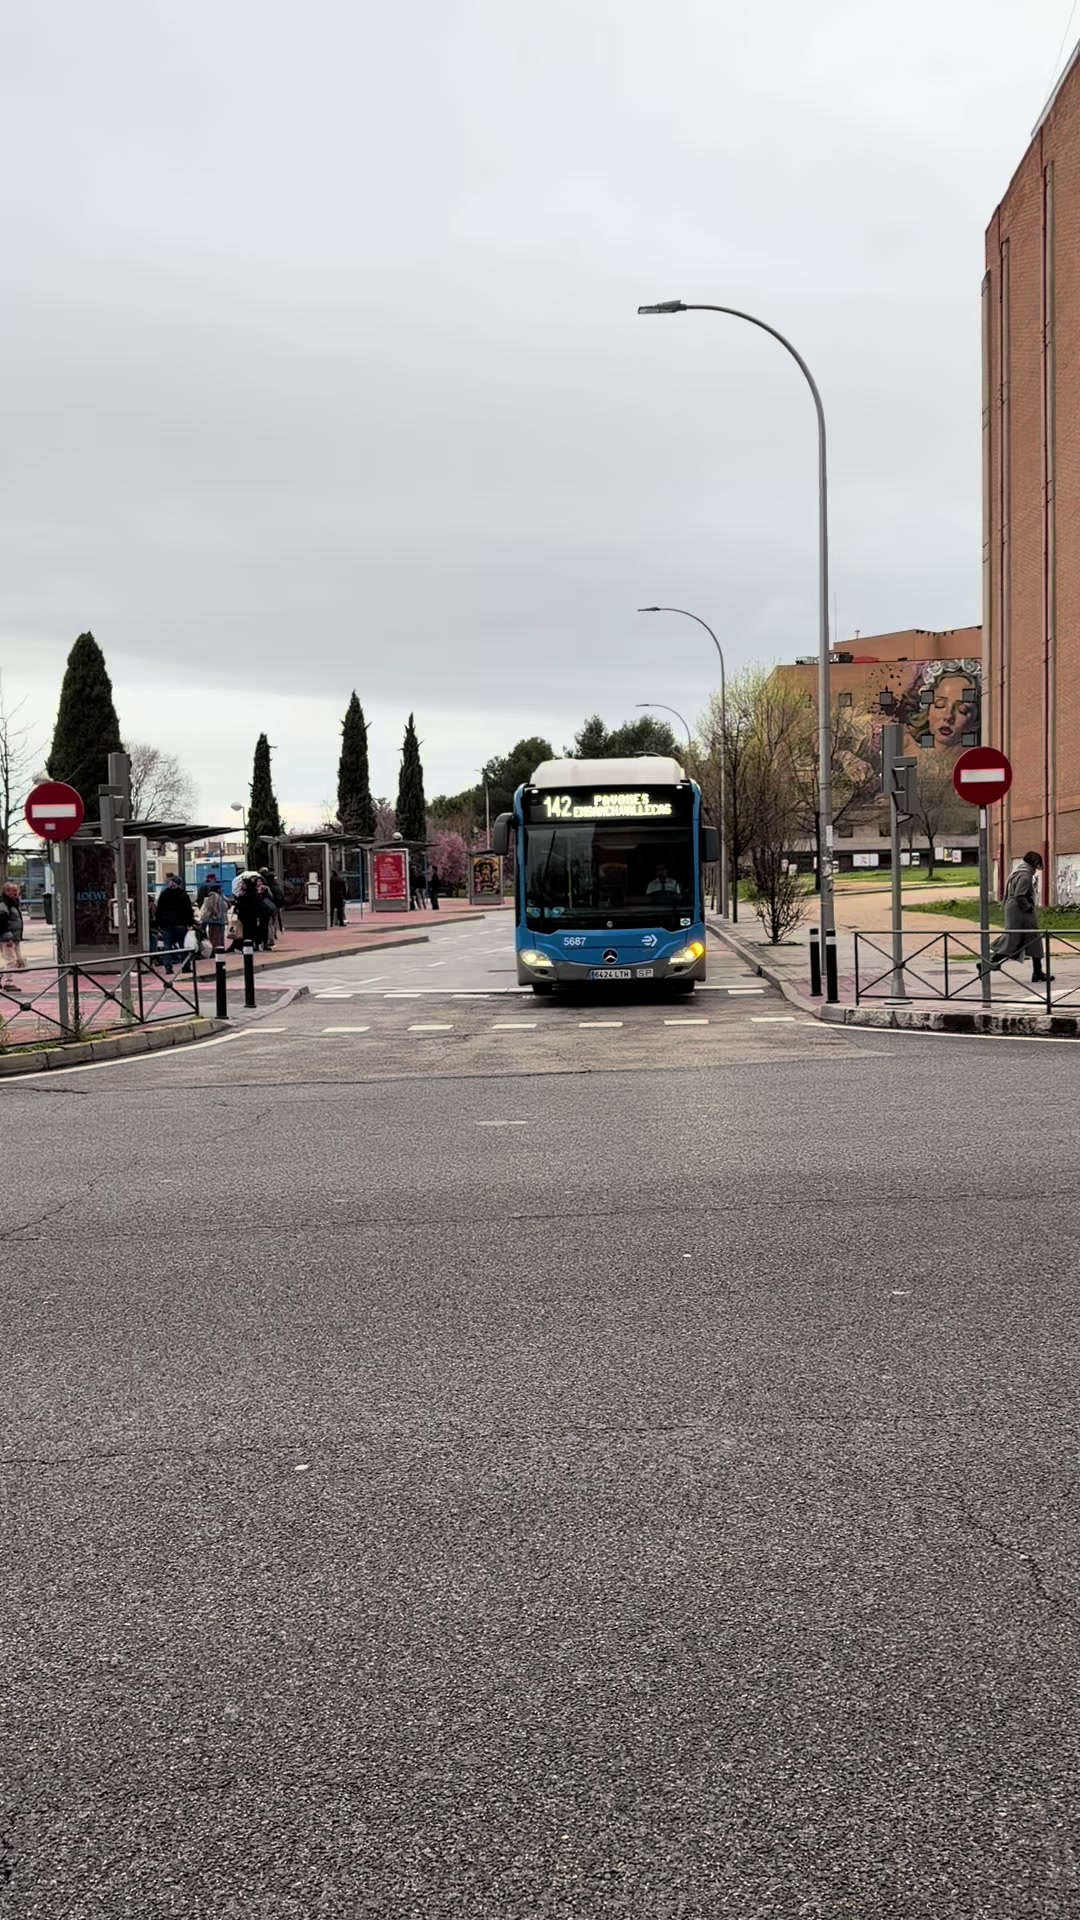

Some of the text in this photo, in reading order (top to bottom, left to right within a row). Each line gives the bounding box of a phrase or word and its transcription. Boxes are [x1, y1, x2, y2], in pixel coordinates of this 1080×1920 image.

[594, 793, 650, 806] PAVONES
[544, 796, 572, 817] 142
[77, 891, 107, 901] LOEWE
[563, 936, 587, 946] 5687
[638, 969, 652, 977] SP
